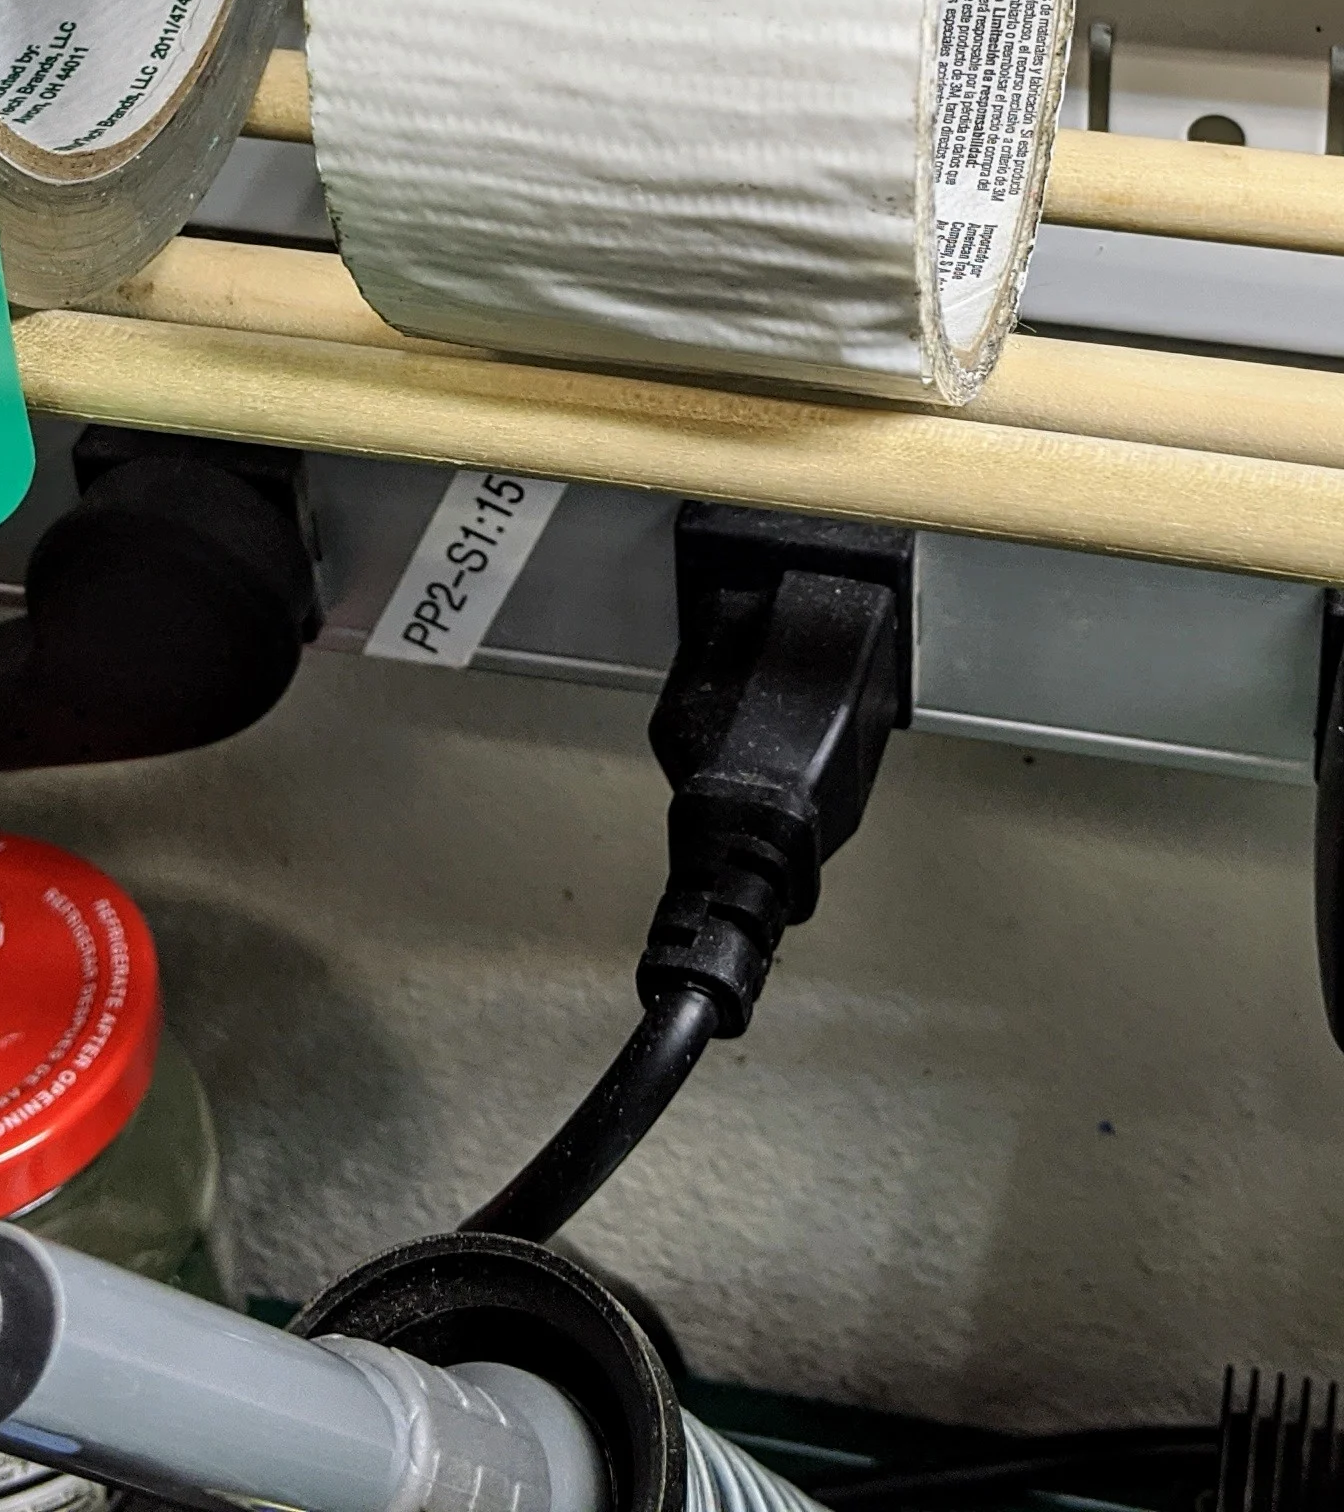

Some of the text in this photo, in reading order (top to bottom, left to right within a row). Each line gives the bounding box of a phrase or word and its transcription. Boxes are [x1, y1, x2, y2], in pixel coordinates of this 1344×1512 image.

[960, 3, 973, 23] este
[1040, 4, 1054, 16] de
[953, 25, 970, 67] producto
[968, 15, 987, 71] responsable
[985, 7, 1007, 66] Limitación
[1018, 45, 1031, 54] el
[1033, 18, 1050, 67] materiales
[14, 43, 41, 64] by:
[19, 21, 77, 95] Brands, LLC
[996, 41, 1015, 93] reembolsar
[12, 46, 90, 125] Avon, OH 44011
[951, 68, 965, 81] de
[962, 73, 978, 89] por
[982, 69, 996, 82] de
[1012, 56, 1028, 91] recurso
[97, 93, 144, 128] Brands,
[131, 65, 158, 89] LLC
[946, 82, 963, 100] 3M,
[963, 91, 977, 99] la
[995, 94, 1008, 103] el
[1022, 76, 1044, 124] fabricación
[942, 102, 959, 125] tanto
[956, 100, 975, 133] pérdida
[965, 84, 992, 168] responsabilidad:
[989, 104, 1004, 132] precio
[935, 126, 954, 159] directos
[987, 133, 1000, 145] de
[1020, 129, 1034, 138] Si
[949, 143, 967, 169] daños
[979, 146, 996, 177] compra
[996, 145, 1013, 175] criterio
[1016, 140, 1030, 158] este
[944, 170, 959, 186] que
[977, 178, 991, 191] del
[994, 176, 1008, 186] de
[1008, 159, 1025, 195] producto
[990, 187, 1006, 202] 3M
[951, 222, 981, 280] American Trade
[967, 224, 998, 278] Importado por
[403, 474, 526, 654] PP2-S1:15
[93, 898, 130, 1008] REFRIGERATE
[73, 1011, 117, 1070] AFTER
